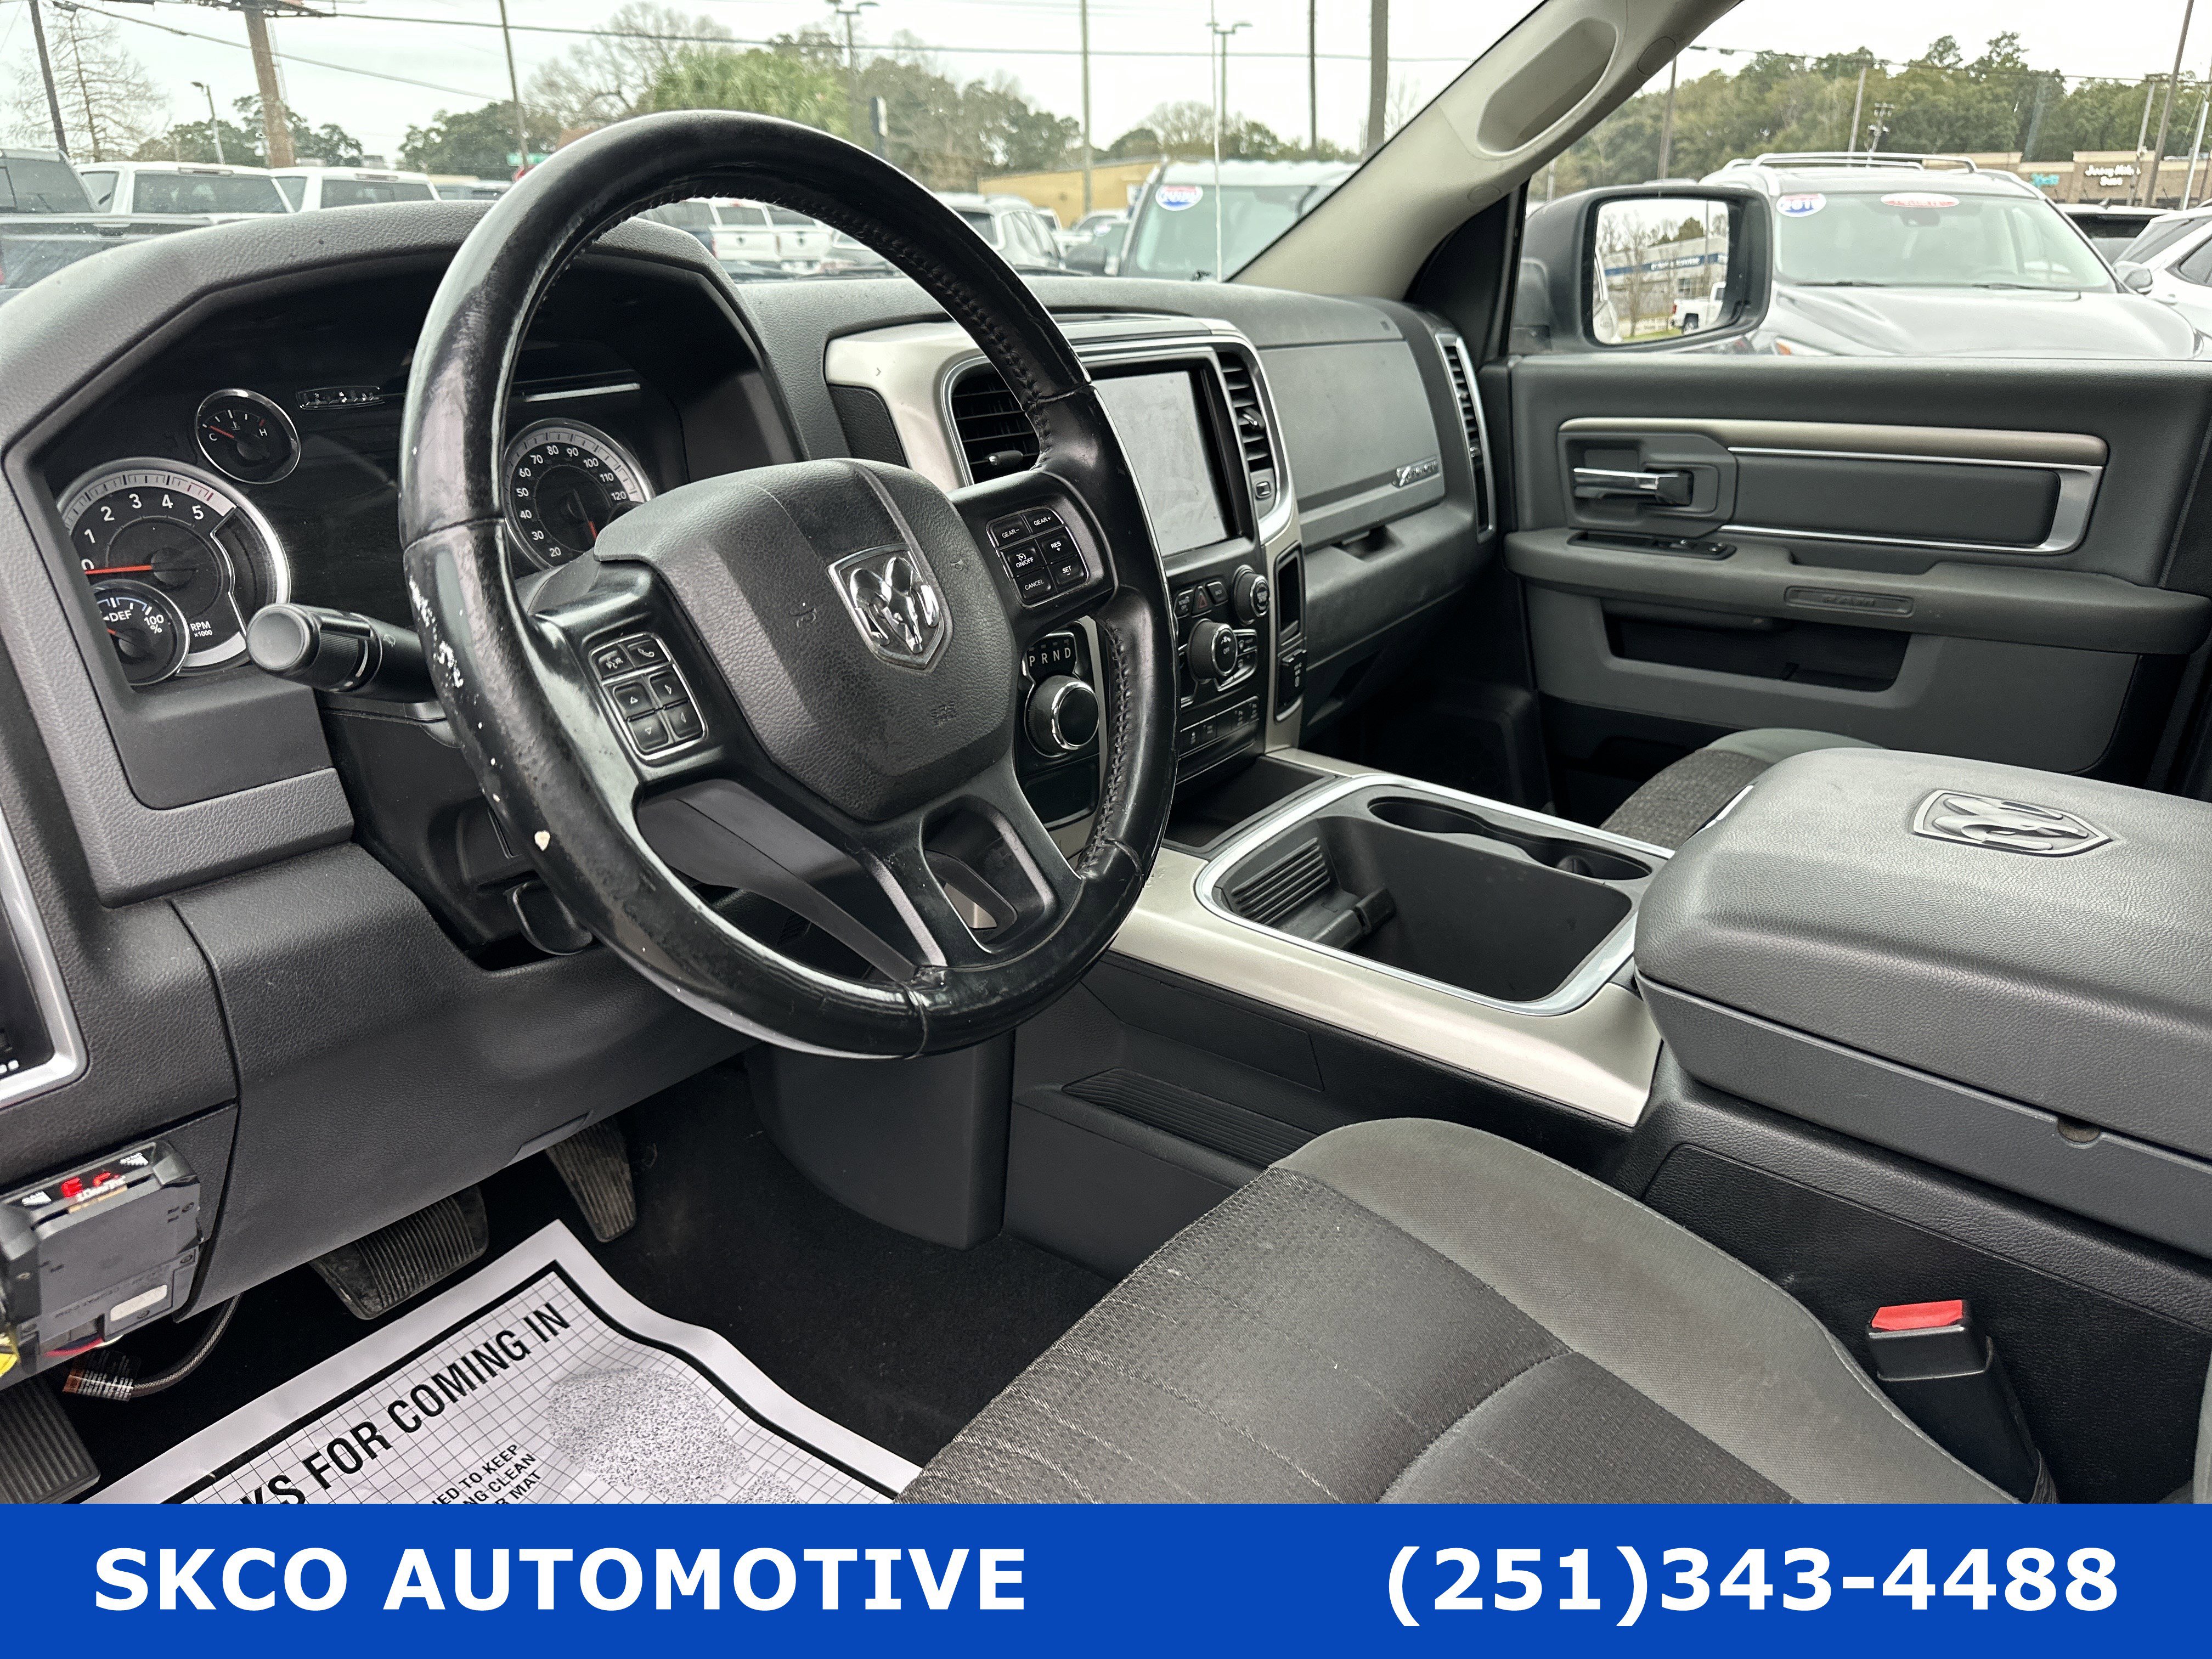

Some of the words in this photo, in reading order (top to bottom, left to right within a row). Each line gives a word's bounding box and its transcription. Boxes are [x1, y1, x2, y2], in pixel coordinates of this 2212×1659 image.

[209, 433, 217, 441] C
[259, 428, 268, 437] H
[546, 445, 559, 455] 80
[566, 447, 579, 458] 90
[530, 454, 544, 465] 70
[583, 458, 599, 469] 100
[519, 467, 532, 477] 60
[600, 472, 614, 482] 110
[516, 488, 529, 497] 50
[611, 491, 627, 501] 120
[129, 494, 142, 509] 3
[162, 494, 173, 509] 4
[100, 506, 115, 521] 2
[192, 505, 204, 520] 5
[520, 510, 532, 519] 40
[1034, 516, 1051, 526] GEAR+
[84, 529, 96, 544] 1
[531, 531, 544, 540] 30
[549, 547, 561, 557] 20
[81, 558, 94, 571] 0
[1015, 557, 1034, 568] ON/OFF
[1062, 566, 1071, 574] SET
[1024, 579, 1045, 590] CANCEL
[109, 610, 132, 622] DEF
[144, 614, 164, 626] 100
[150, 624, 162, 634] %
[190, 620, 211, 631] RPM
[1029, 656, 1035, 667] P
[1041, 653, 1048, 664] R
[1053, 650, 1060, 661] N
[1064, 647, 1071, 658] D
[302, 1421, 392, 1490] FOR
[387, 1329, 532, 1434] COMING
[523, 1302, 571, 1342] IN
[459, 1472, 482, 1488] TO
[482, 1444, 517, 1475] KEEP
[488, 1454, 536, 1492] CLEAN
[509, 1470, 541, 1499] MAT
